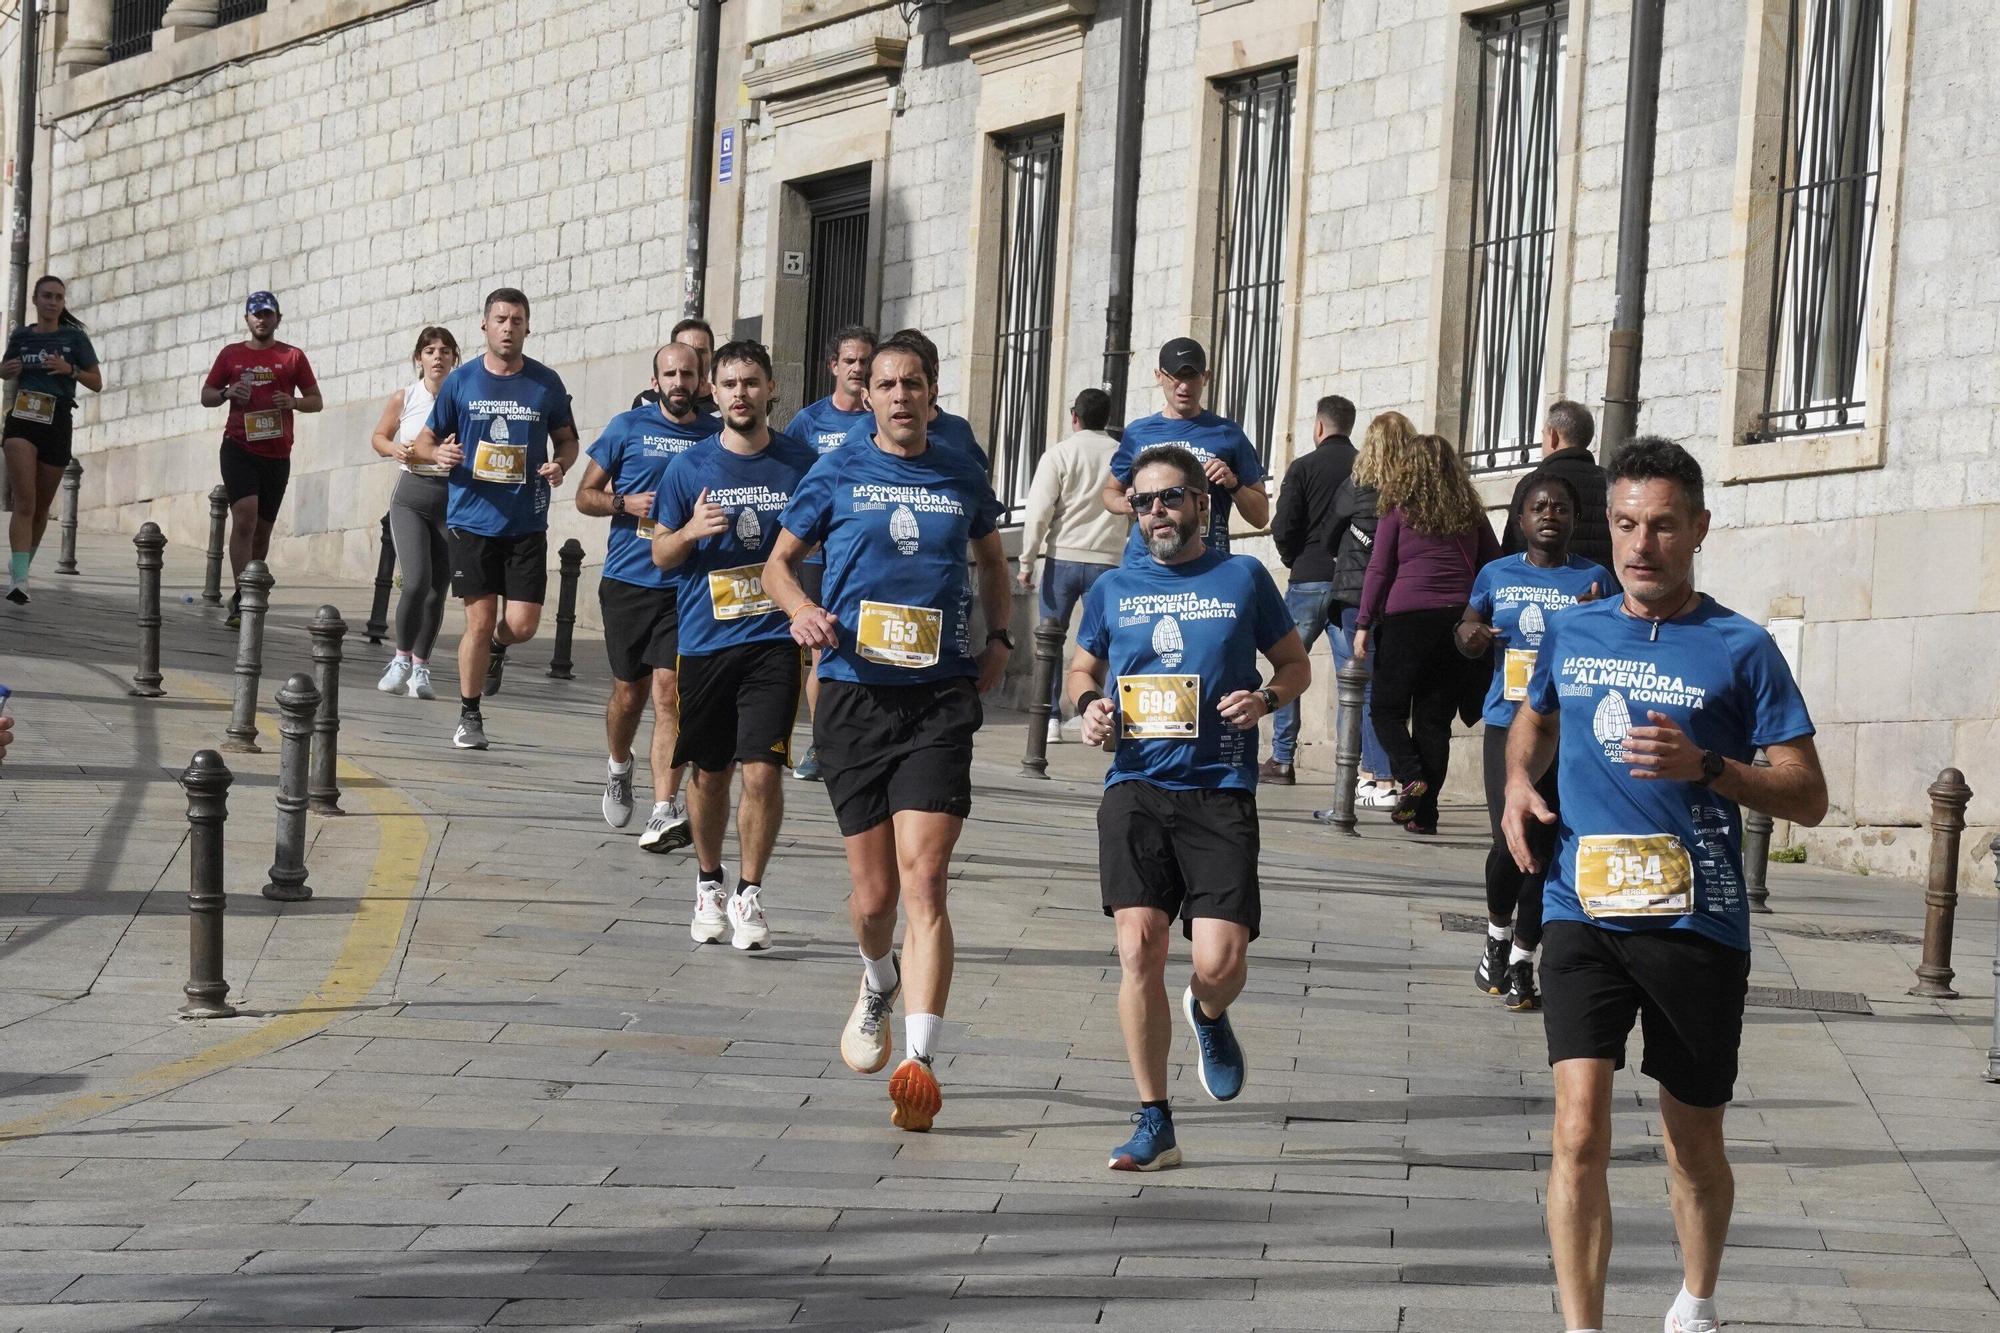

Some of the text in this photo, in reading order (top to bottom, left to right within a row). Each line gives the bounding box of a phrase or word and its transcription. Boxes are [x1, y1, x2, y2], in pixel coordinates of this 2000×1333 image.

[787, 255, 800, 270] 5
[27, 398, 41, 410] 38
[479, 406, 531, 414] ALMENDRA
[255, 417, 274, 428] 496
[488, 453, 515, 469] 404
[717, 486, 769, 497] CONQUISTA
[867, 485, 928, 495] CONQUISTA
[720, 492, 788, 506] ALMENDRA
[869, 493, 951, 505] ALMENDRA
[915, 504, 965, 516] KONKISTA
[1506, 586, 1559, 595] CONQUISTA
[1132, 592, 1197, 604] CONQUISTA
[1506, 593, 1578, 605] ALMENDRA
[1134, 598, 1221, 615] ALMENDRA
[1180, 609, 1236, 621] KONKISTA
[880, 620, 918, 645] 153
[1563, 657, 1656, 674] LA CONQUISTA
[1574, 669, 1684, 693] ALMENDRA
[1685, 686, 1706, 697] REN
[1139, 690, 1177, 714] 698
[1629, 688, 1704, 710] KONKISTA
[1606, 855, 1664, 887] 354
